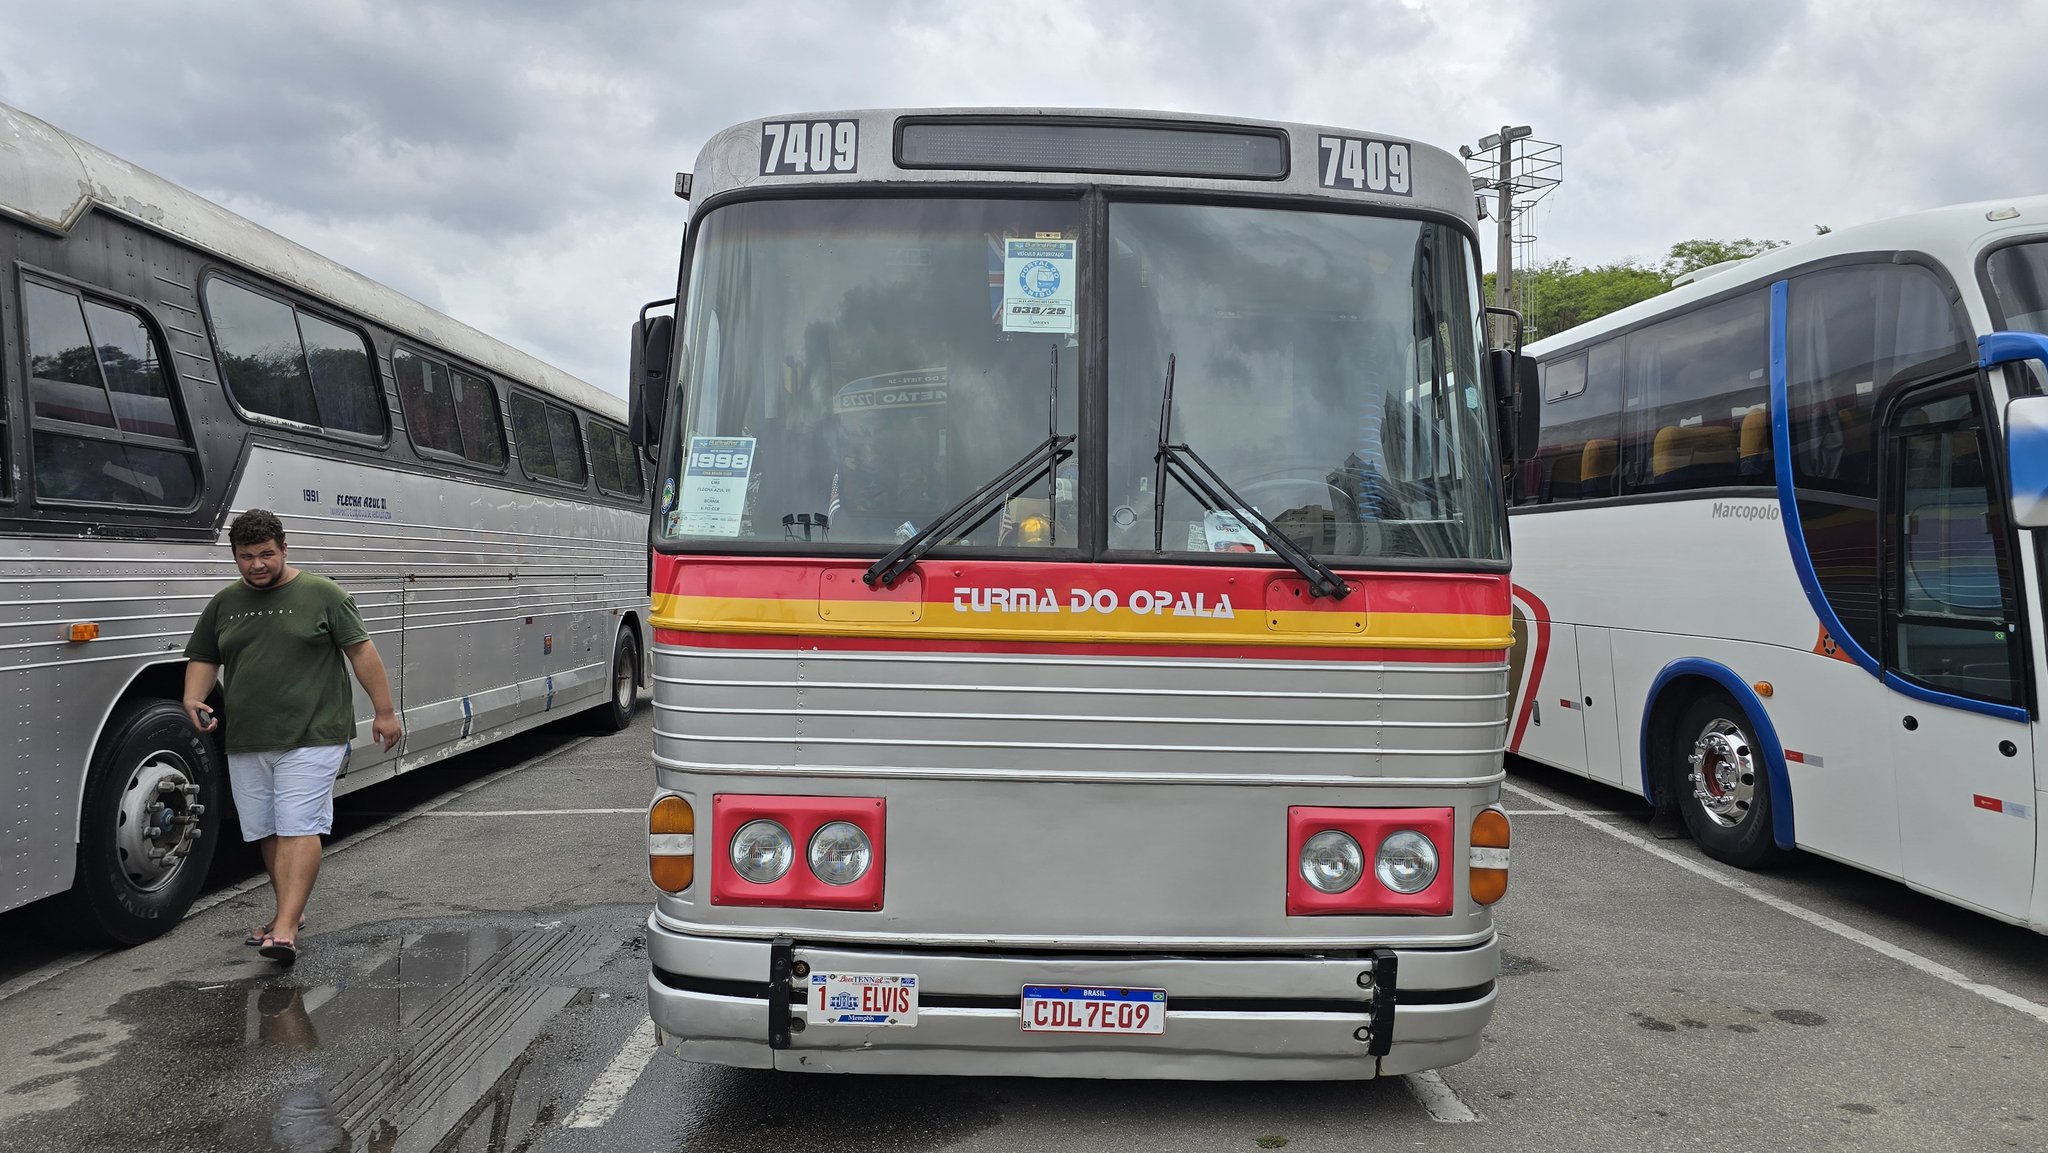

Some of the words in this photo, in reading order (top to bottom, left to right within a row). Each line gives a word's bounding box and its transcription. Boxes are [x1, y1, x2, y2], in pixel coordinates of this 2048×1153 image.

[765, 122, 856, 173] 7409
[1321, 137, 1410, 193] 7409
[1021, 260, 1049, 278] PORTAL
[1051, 267, 1059, 279] DO
[1012, 306, 1066, 315] 038/25
[691, 452, 749, 469] 1998
[303, 489, 319, 502] 1991
[337, 494, 361, 507] FLECHA
[363, 496, 380, 509] AZUL
[1712, 502, 1779, 521] Marcopolo
[954, 587, 1060, 613] TURMA
[1070, 588, 1118, 614] DO
[1128, 590, 1235, 619] OPALA
[818, 985, 827, 1011] 1
[862, 986, 910, 1013] ELVIS
[1083, 989, 1106, 997] BRASIL
[848, 1014, 875, 1022] Memphis
[1034, 1000, 1150, 1029] CDL7E09
[1023, 1020, 1032, 1029] BR
